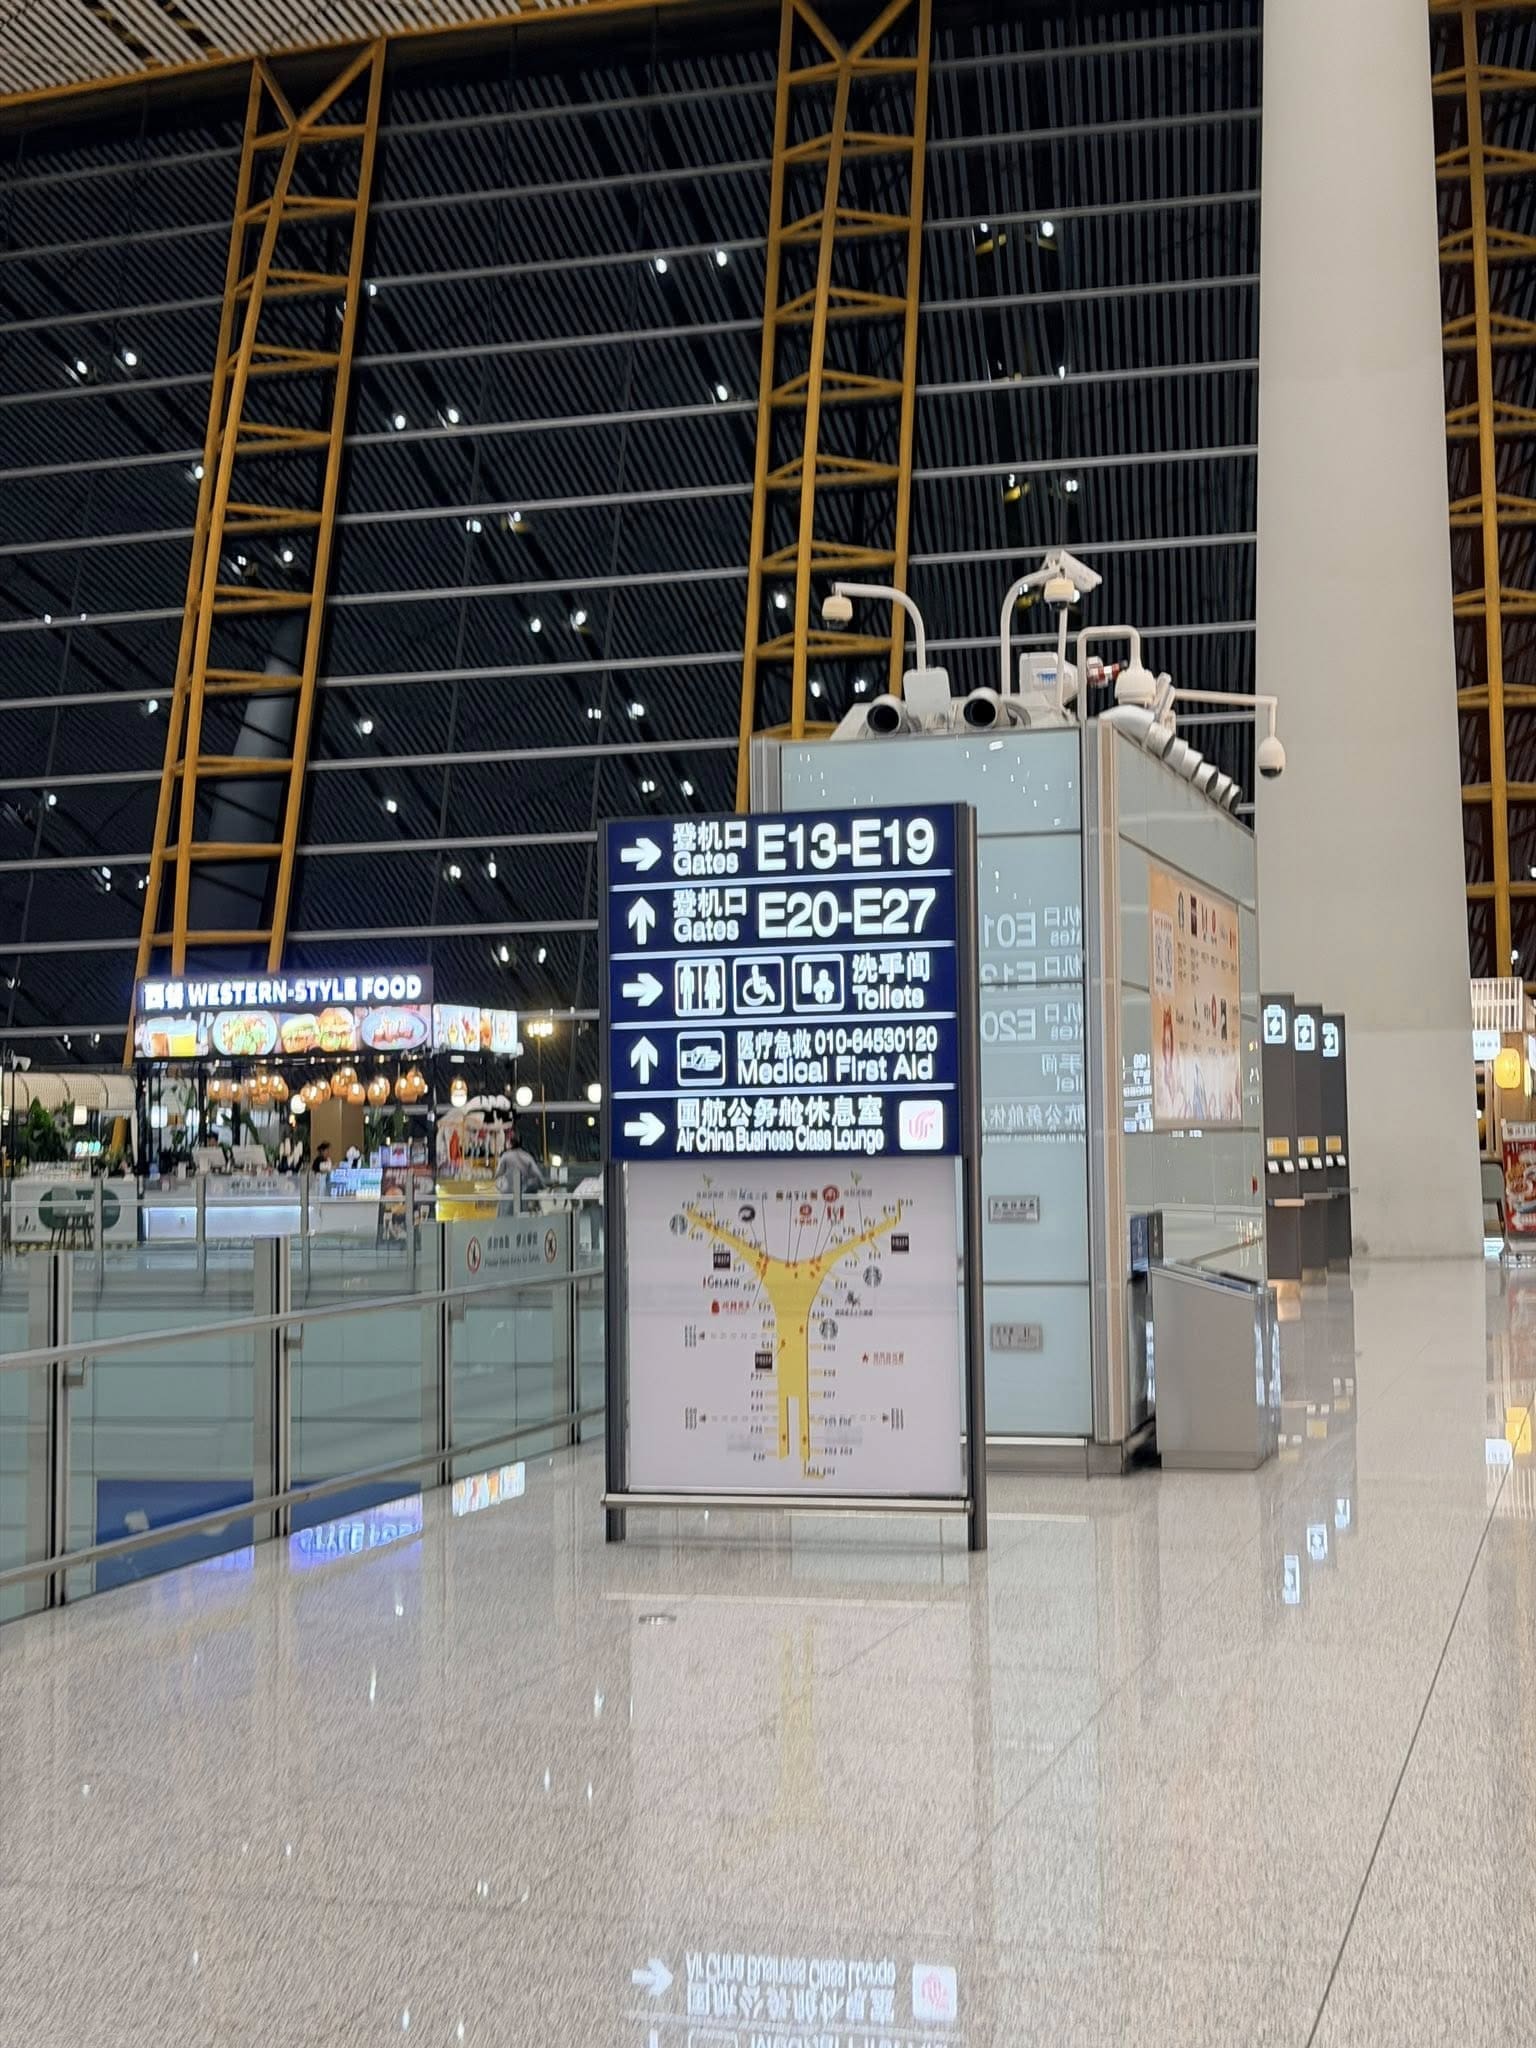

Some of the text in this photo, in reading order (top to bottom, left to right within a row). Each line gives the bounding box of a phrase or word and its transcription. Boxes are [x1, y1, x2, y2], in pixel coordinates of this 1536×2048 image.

[672, 820, 747, 852] 登机口
[757, 818, 935, 871] E13-E19
[672, 850, 739, 877] Gates
[672, 887, 747, 919] 登机口
[758, 887, 936, 940] E20-E27
[672, 918, 740, 943] Gates
[851, 951, 931, 983] 洗手间
[188, 974, 423, 1007] WESTERN-STYLE FOOD
[851, 983, 926, 1011] Toilets
[736, 1029, 811, 1060] 医疗急救
[814, 1026, 938, 1055] 010-64530120
[737, 1052, 933, 1086] Medical First Aid
[676, 1095, 883, 1128] 国航公务舱休息室
[676, 1124, 885, 1155] Air China Business Class Lounge
